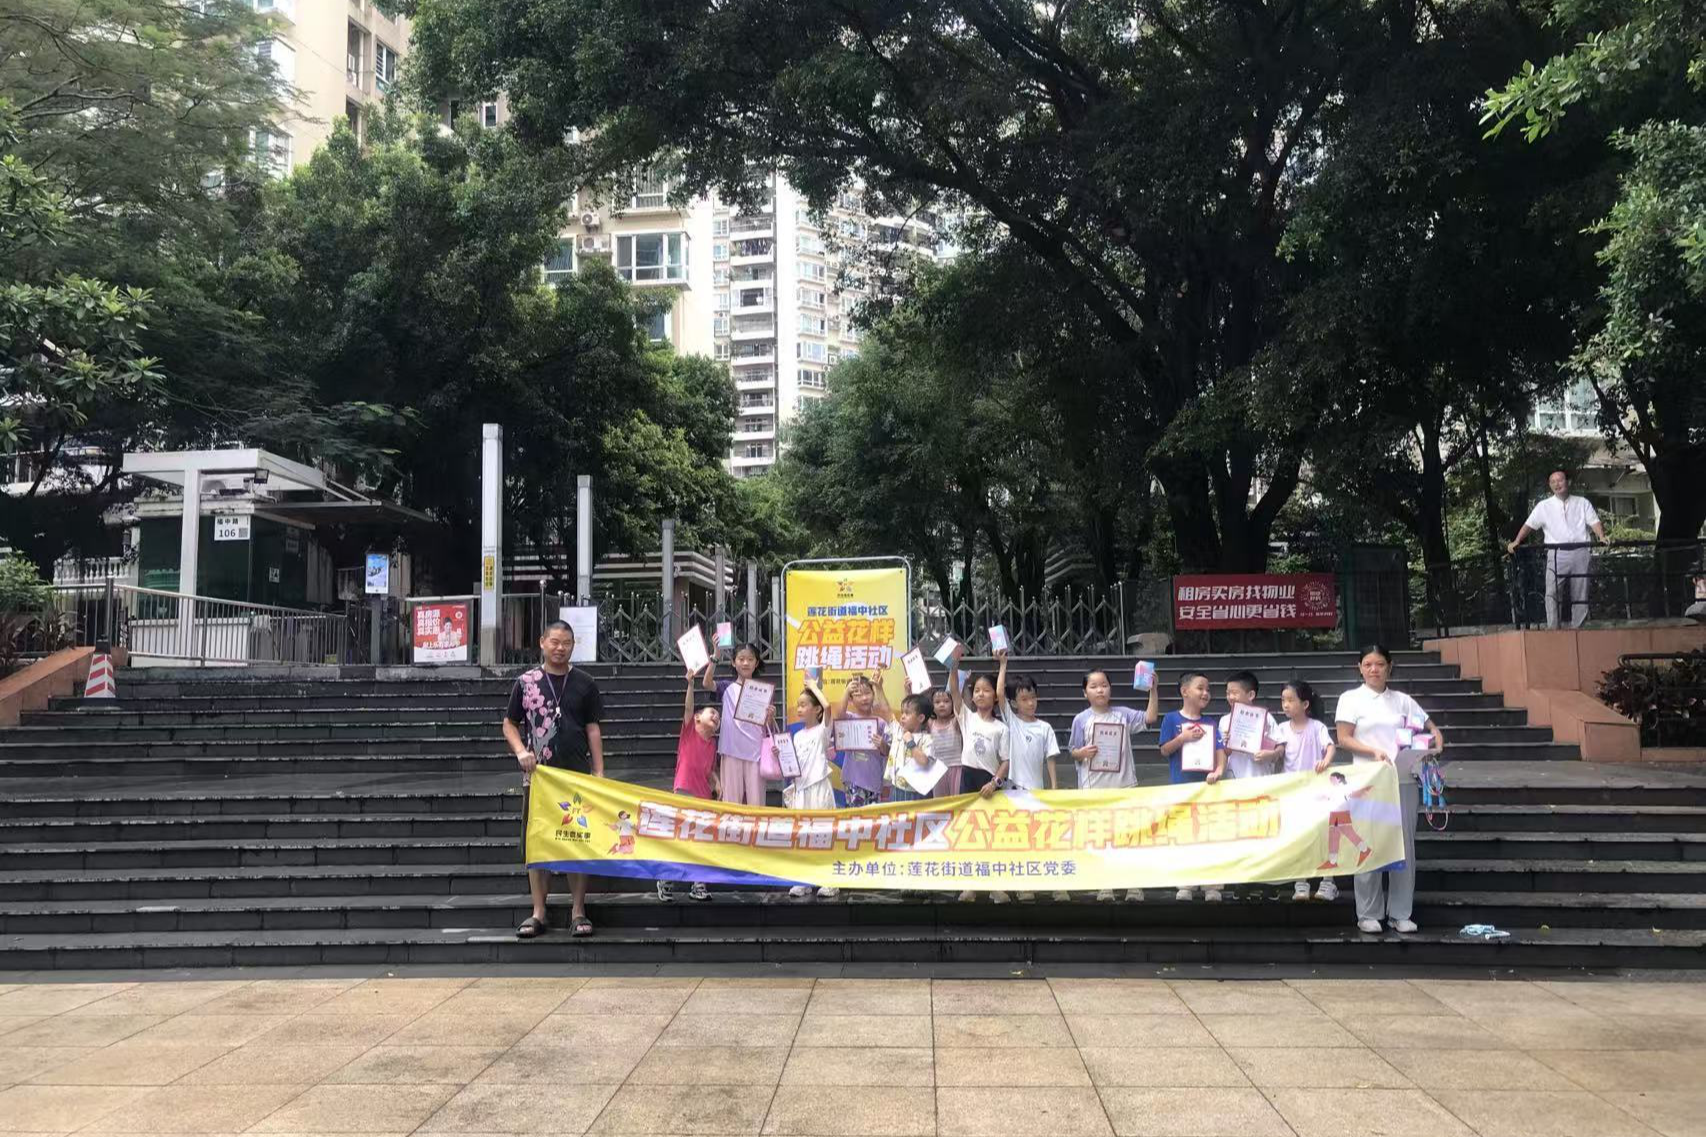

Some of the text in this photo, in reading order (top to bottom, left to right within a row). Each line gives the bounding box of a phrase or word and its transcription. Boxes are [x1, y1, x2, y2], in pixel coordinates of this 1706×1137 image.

[219, 529, 236, 538] 106
[1178, 585, 1296, 601] 租房买房找物业
[807, 605, 888, 617] 莲花街道福中社区
[1179, 604, 1296, 620] 安全省心更省钱
[798, 618, 895, 645] 公益花样
[794, 645, 893, 670] 跳绳活动
